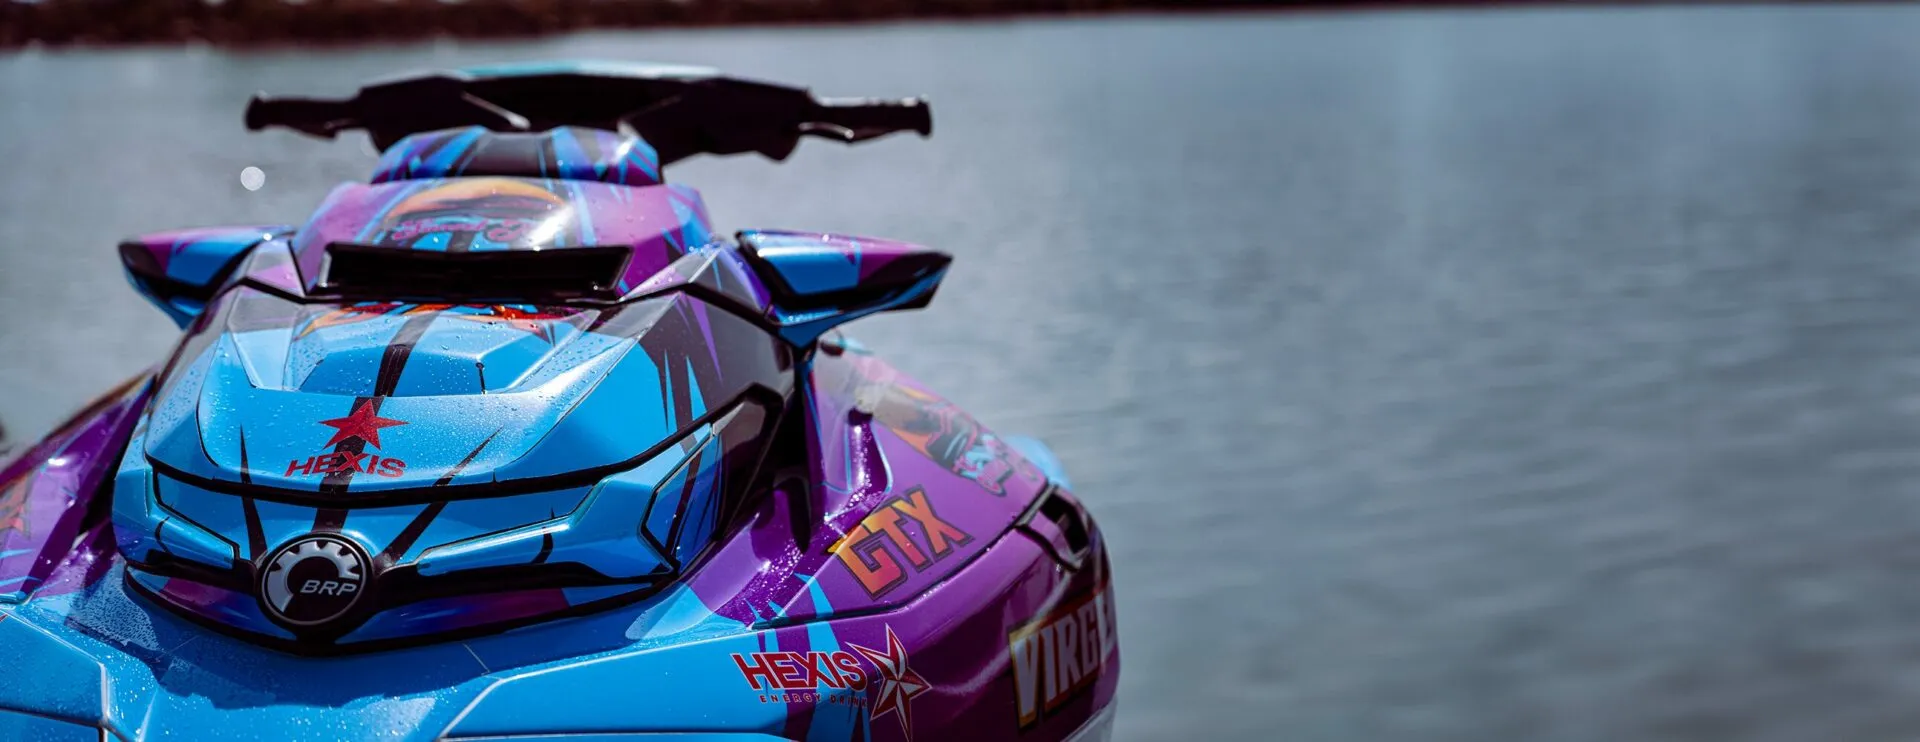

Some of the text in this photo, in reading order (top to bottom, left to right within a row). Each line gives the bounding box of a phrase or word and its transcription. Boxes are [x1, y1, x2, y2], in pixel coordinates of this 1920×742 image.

[284, 451, 407, 478] HEXIS
[828, 485, 976, 602] GTX
[300, 579, 357, 596] BRP
[730, 651, 868, 692] HEXIS
[759, 692, 868, 708] ENERGY DRINK
